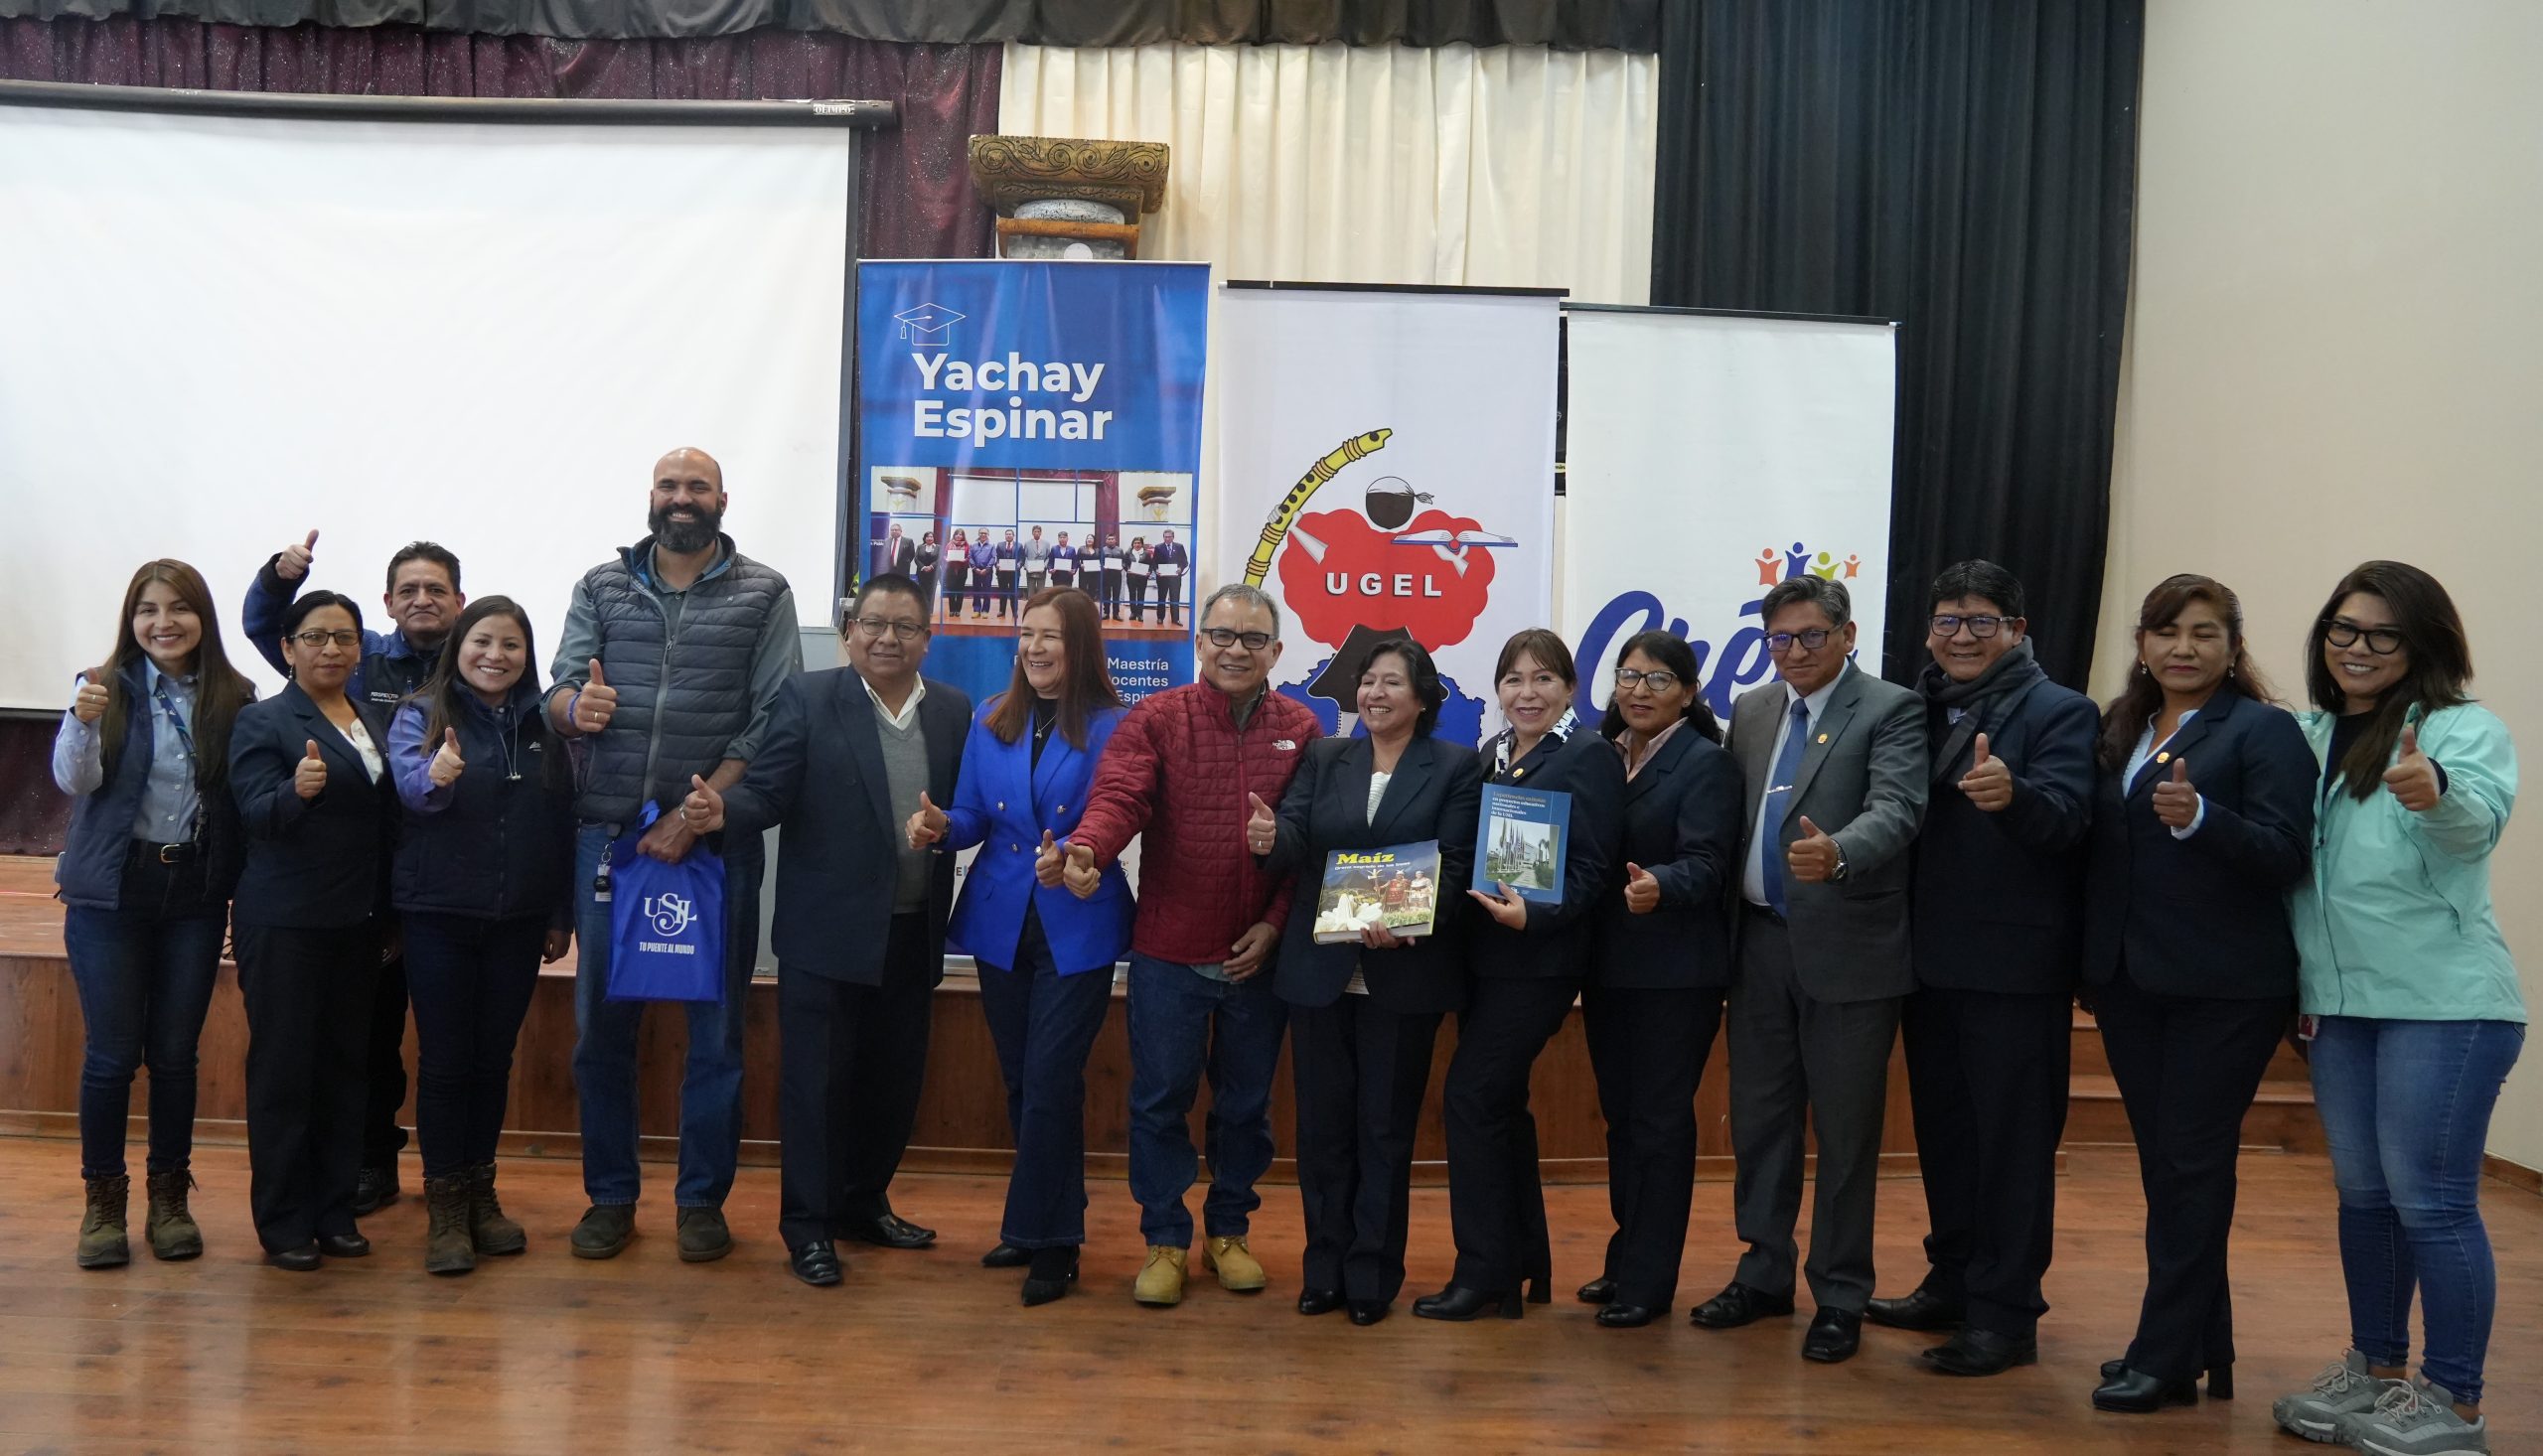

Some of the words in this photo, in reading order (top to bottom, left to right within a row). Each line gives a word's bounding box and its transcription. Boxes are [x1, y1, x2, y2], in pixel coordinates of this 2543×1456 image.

[912, 352, 1105, 402] Yachay
[914, 396, 1113, 448] Espinar
[1325, 571, 1442, 598] UGEL
[1108, 657, 1169, 671] Maestría
[1110, 674, 1169, 687] ocentes
[1336, 852, 1395, 865] Maíz
[640, 942, 647, 951] TU
[647, 942, 668, 953] PUENTE
[667, 944, 674, 953] AL
[674, 944, 695, 954] MUNDO
